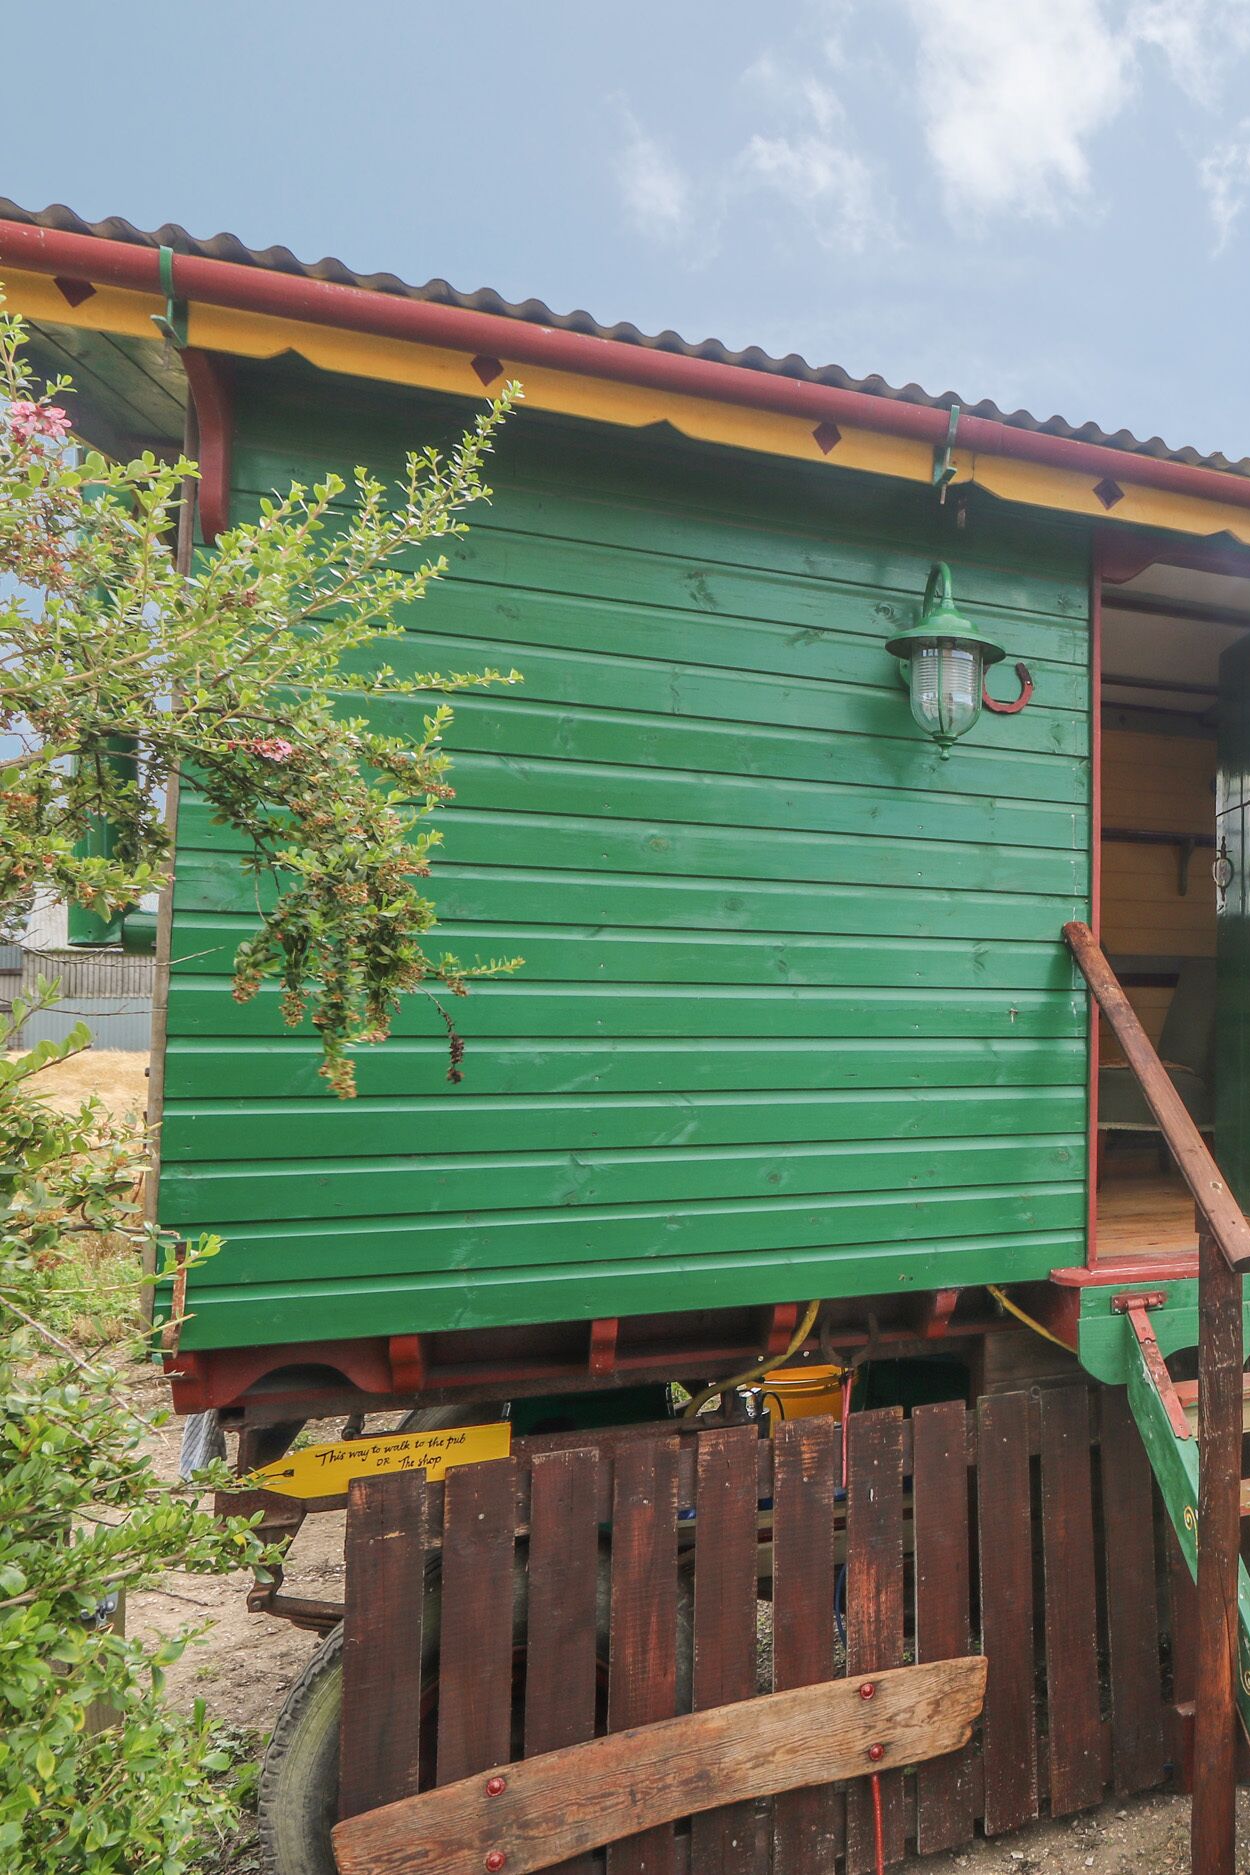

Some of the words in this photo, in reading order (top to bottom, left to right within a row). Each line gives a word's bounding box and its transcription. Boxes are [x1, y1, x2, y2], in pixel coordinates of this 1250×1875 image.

[315, 1450, 346, 1467] This
[348, 1449, 370, 1462] way
[371, 1445, 381, 1454] to
[384, 1440, 410, 1453] walk
[415, 1440, 425, 1448] to
[428, 1436, 444, 1448] the
[445, 1433, 466, 1450] pub
[376, 1457, 390, 1467] OR
[398, 1455, 415, 1469] The
[417, 1453, 442, 1470] shop
